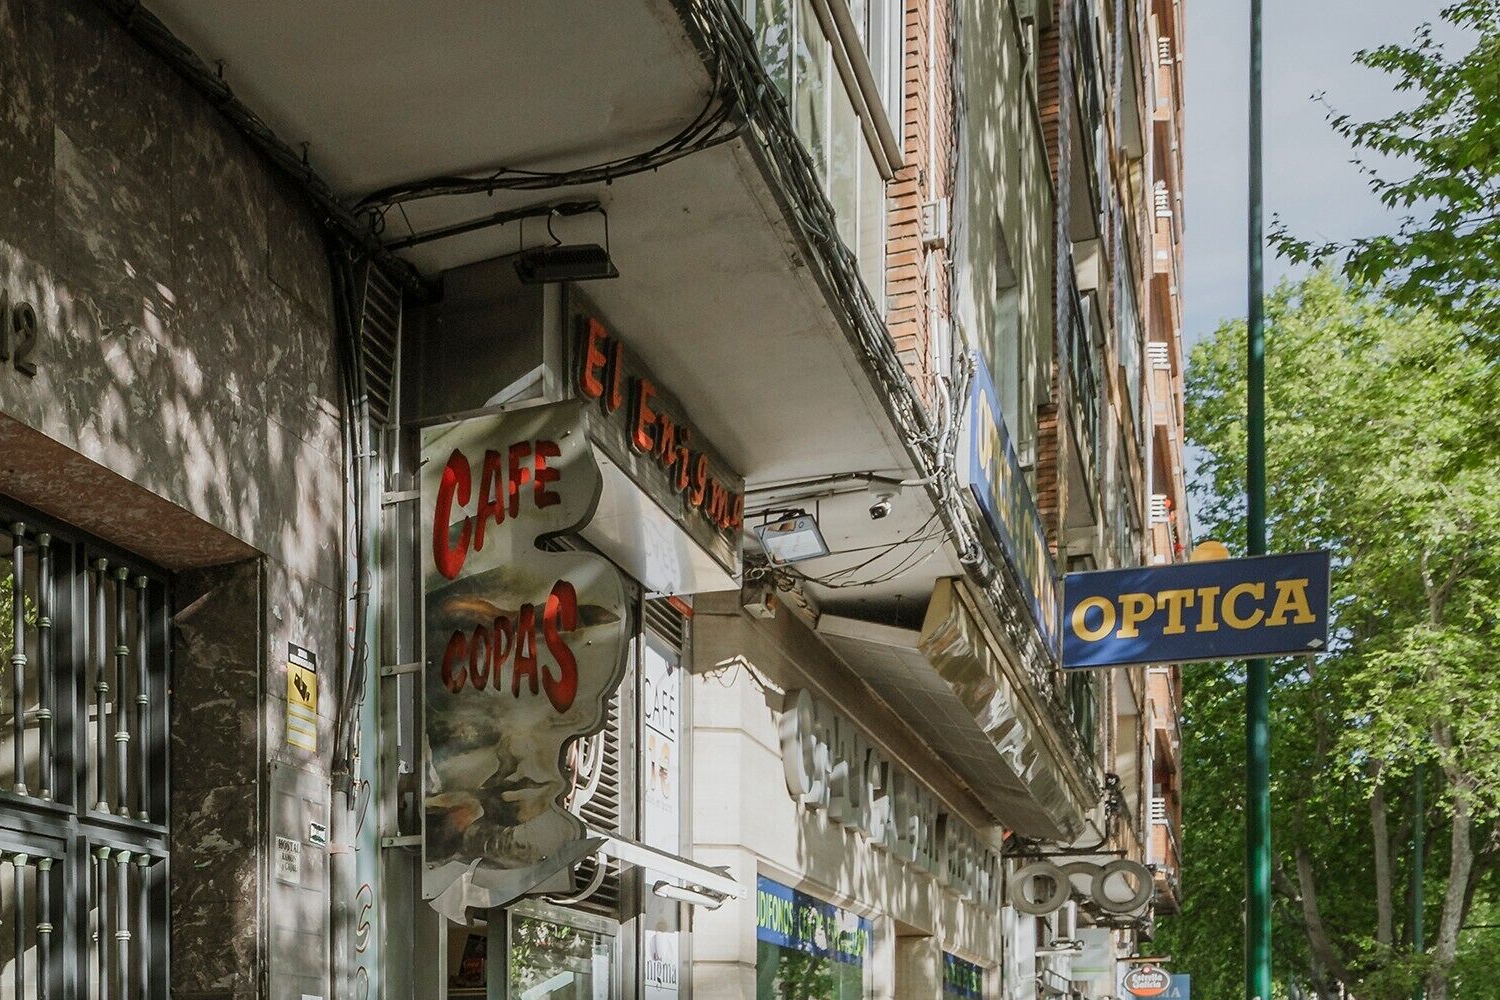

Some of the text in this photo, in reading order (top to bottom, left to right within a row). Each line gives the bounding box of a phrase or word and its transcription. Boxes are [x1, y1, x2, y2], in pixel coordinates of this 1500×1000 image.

[432, 440, 561, 581] CAFE
[441, 579, 578, 714] COPAS
[1071, 578, 1316, 642] OPTICA
